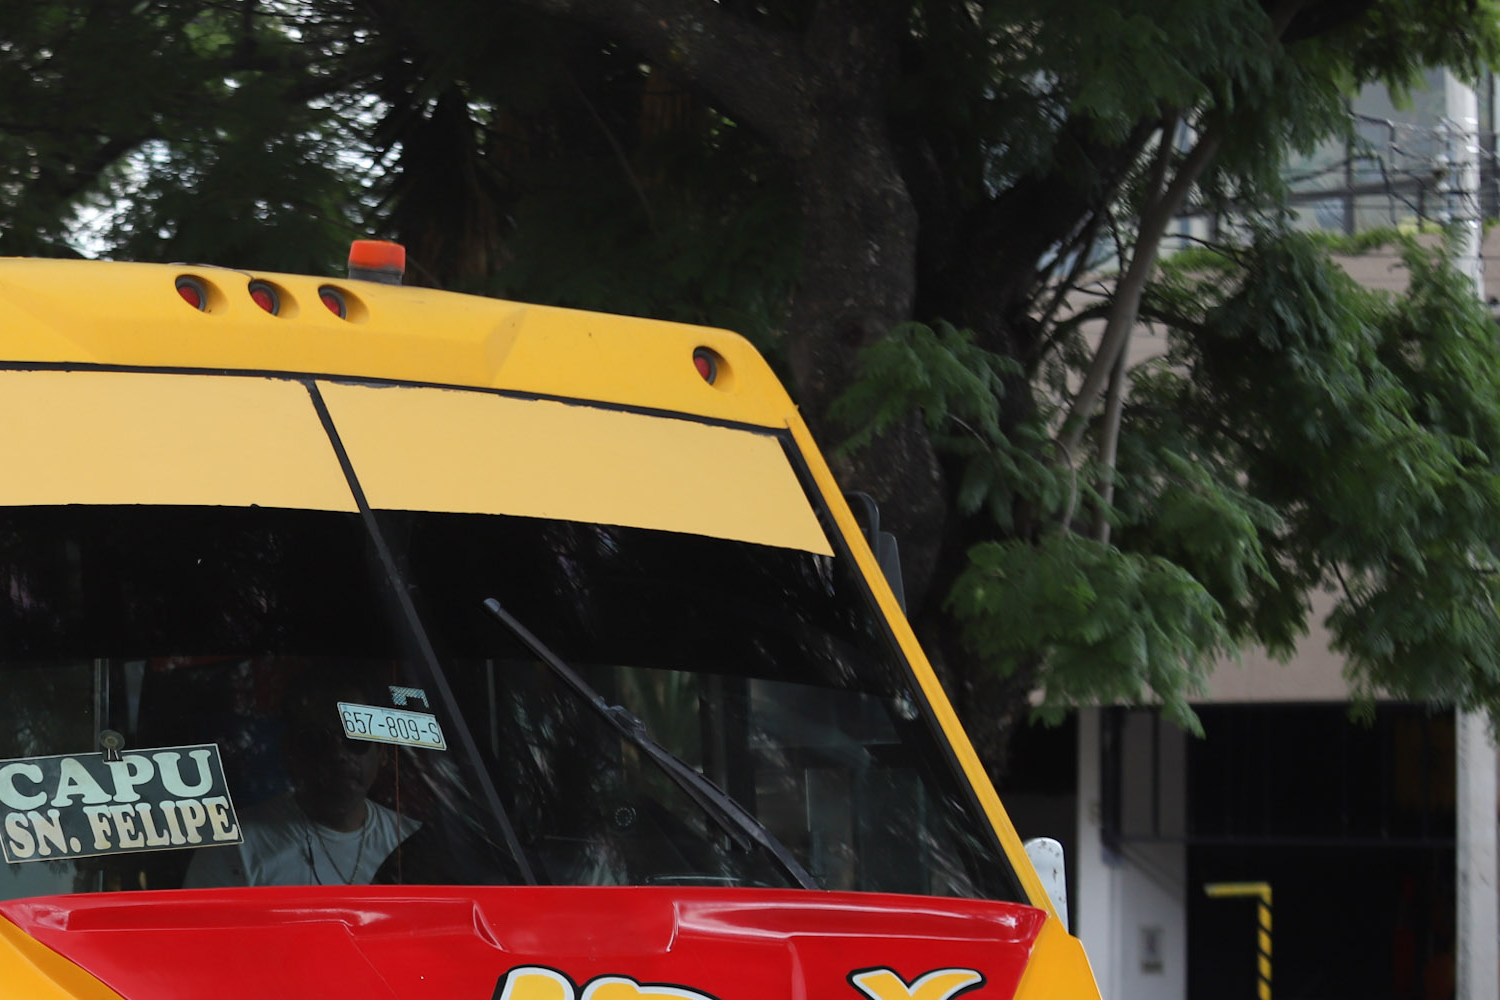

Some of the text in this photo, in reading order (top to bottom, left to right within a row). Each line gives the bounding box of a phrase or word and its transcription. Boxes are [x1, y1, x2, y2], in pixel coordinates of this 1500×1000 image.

[342, 711, 441, 744] 657-809-S
[5, 809, 82, 858] SN.
[83, 796, 238, 850] FELIPE
